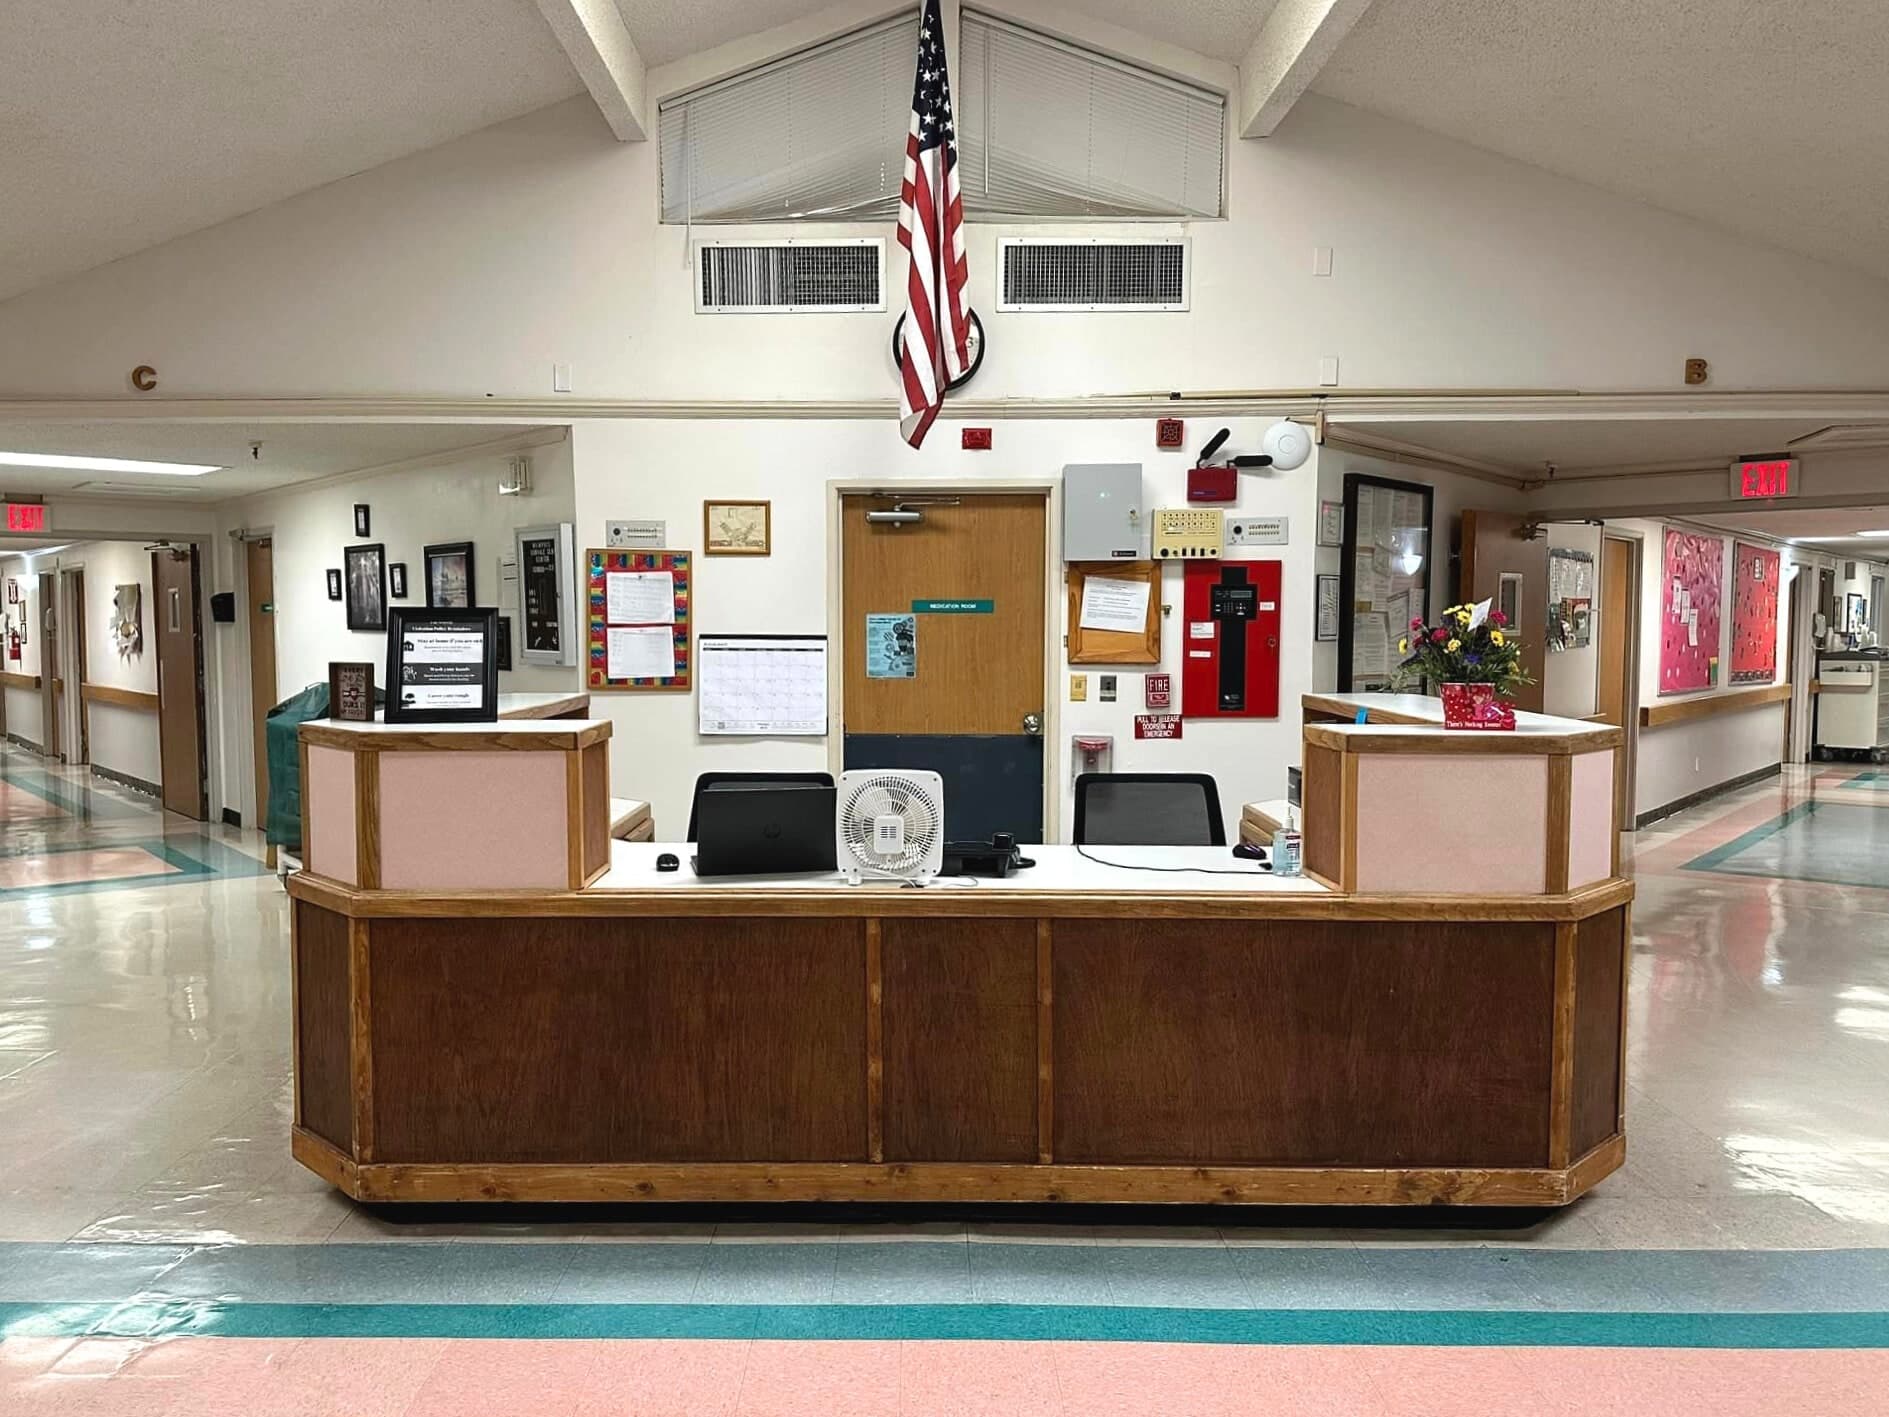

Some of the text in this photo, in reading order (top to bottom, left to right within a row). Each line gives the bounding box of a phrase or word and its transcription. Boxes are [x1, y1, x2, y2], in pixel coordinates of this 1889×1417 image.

[131, 365, 157, 391] C
[1685, 359, 1708, 385] B
[1742, 461, 1790, 497] EXIT
[8, 504, 44, 530] EXIT
[1149, 679, 1169, 691] FIRE
[1137, 715, 1149, 723] PULL
[1158, 714, 1180, 722] RELEASE
